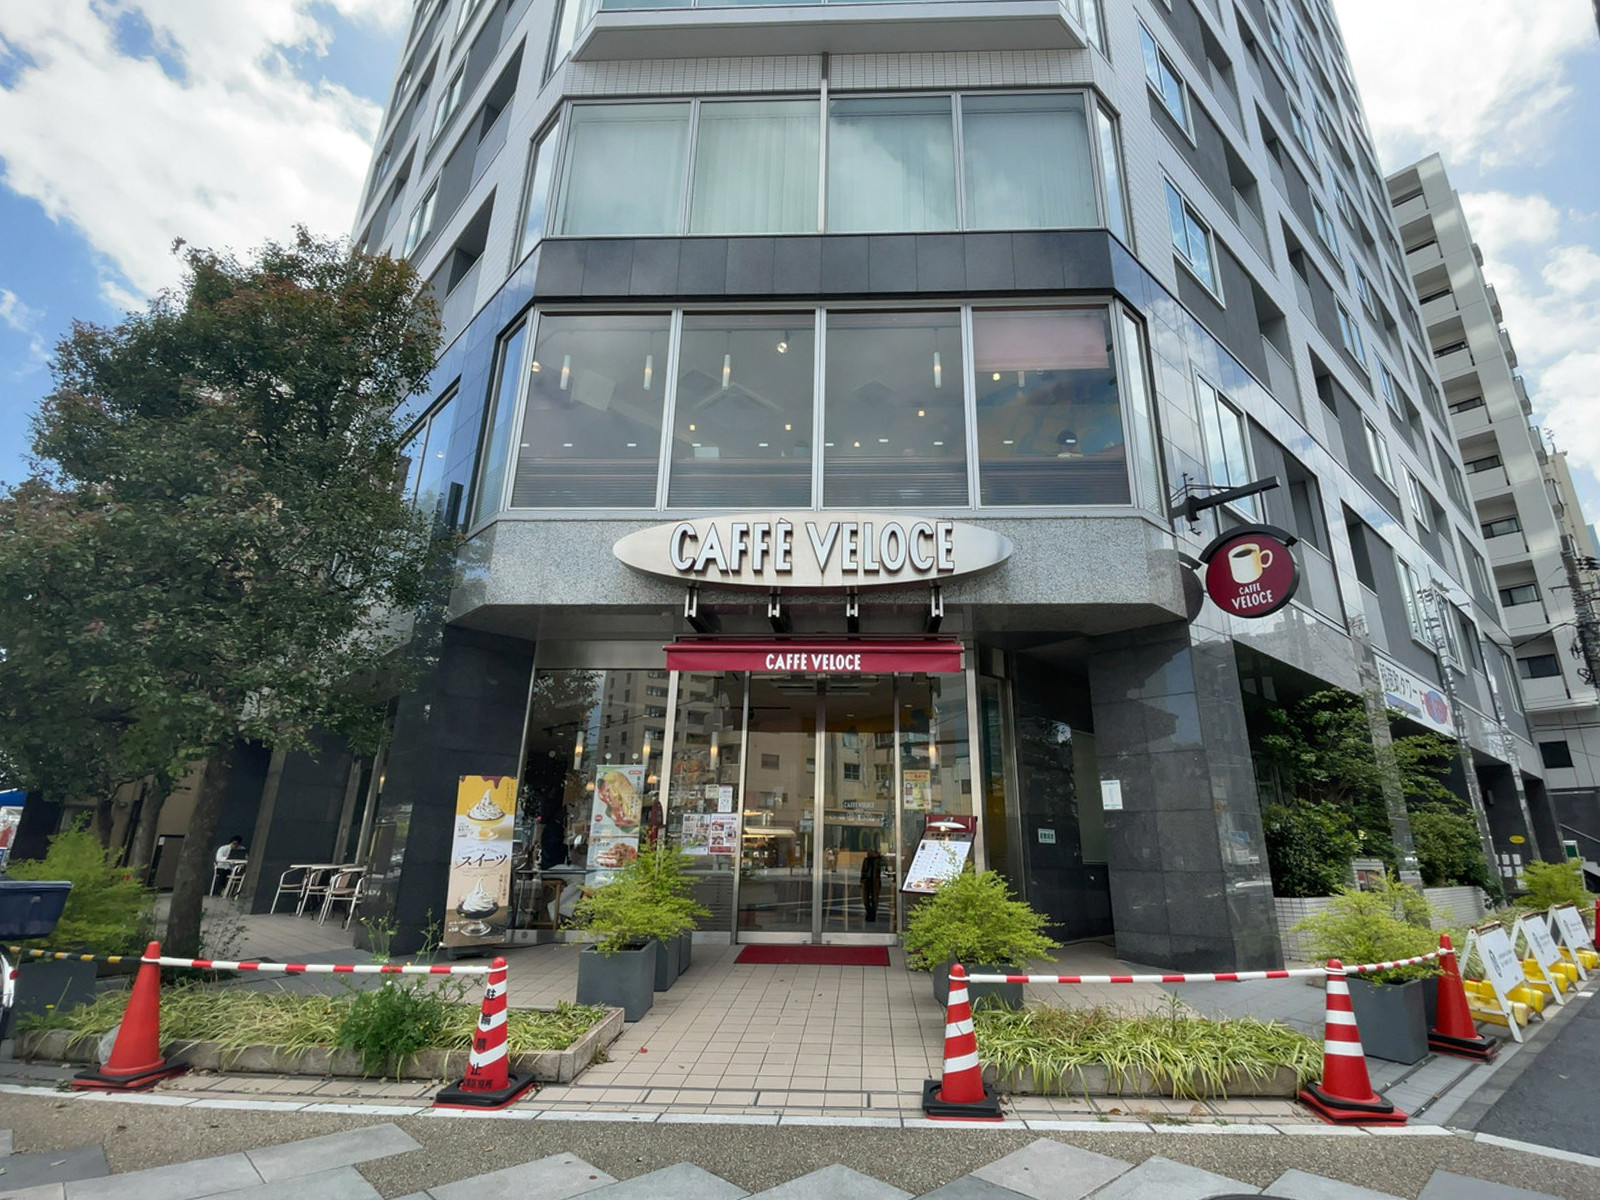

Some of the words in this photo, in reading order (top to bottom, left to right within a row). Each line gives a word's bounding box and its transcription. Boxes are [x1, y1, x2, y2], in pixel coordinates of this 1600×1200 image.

[669, 517, 793, 574] CAFFÈ
[804, 521, 955, 574] VELOCE
[1231, 589, 1274, 611] VELOCE
[810, 653, 861, 671] VELOCE
[453, 852, 508, 870] スイーツ
